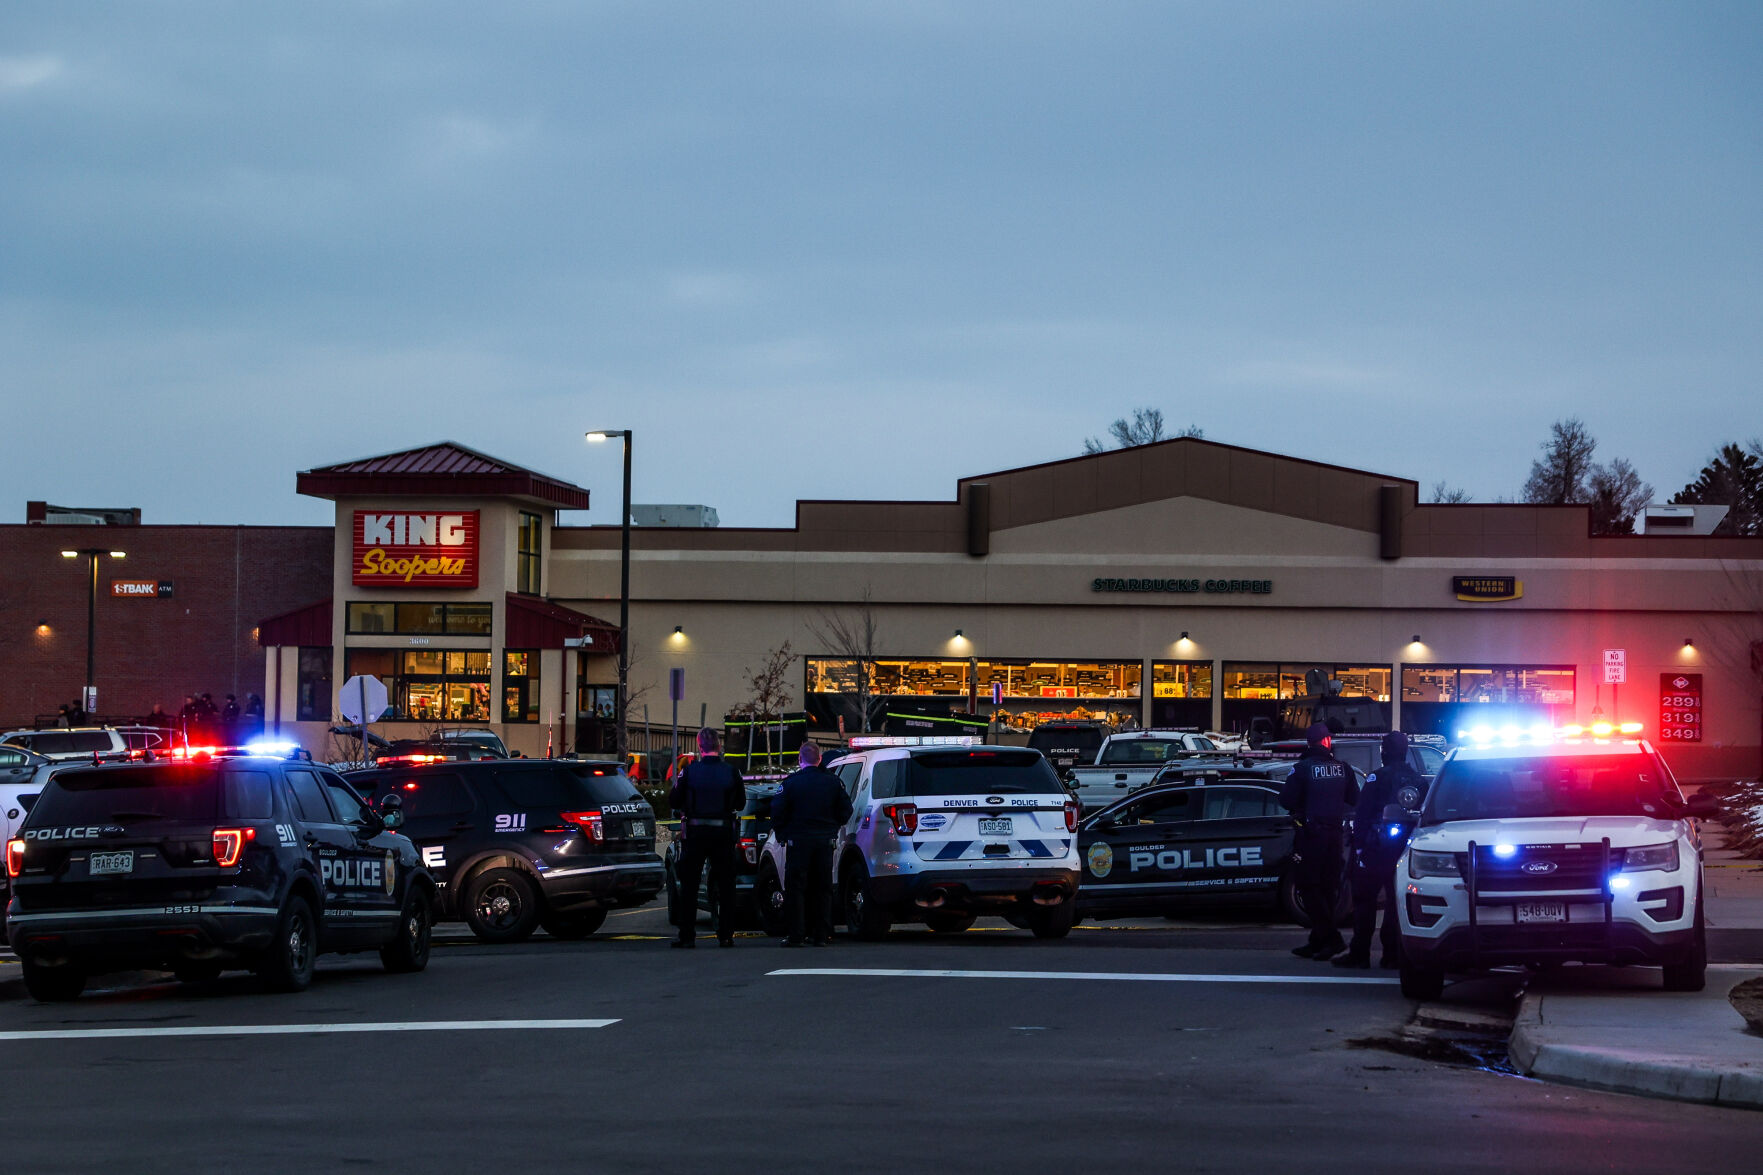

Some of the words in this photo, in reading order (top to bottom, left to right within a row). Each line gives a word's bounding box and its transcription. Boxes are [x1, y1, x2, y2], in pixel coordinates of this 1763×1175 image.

[363, 514, 465, 545] KING
[360, 548, 466, 583] Soopers
[1093, 579, 1200, 593] STARBUCKS
[1204, 580, 1272, 593] COFFEE
[1662, 696, 1694, 707] 289
[1662, 712, 1694, 723] 319
[1662, 728, 1694, 739] 349
[1314, 765, 1343, 778] POLICE
[601, 804, 638, 815] POLICE
[495, 813, 527, 829] 911
[24, 826, 100, 841] POLICE
[275, 823, 297, 842] 911
[1130, 846, 1264, 872] POLICE
[319, 858, 382, 887] POLICE
[165, 905, 200, 914] 2553
